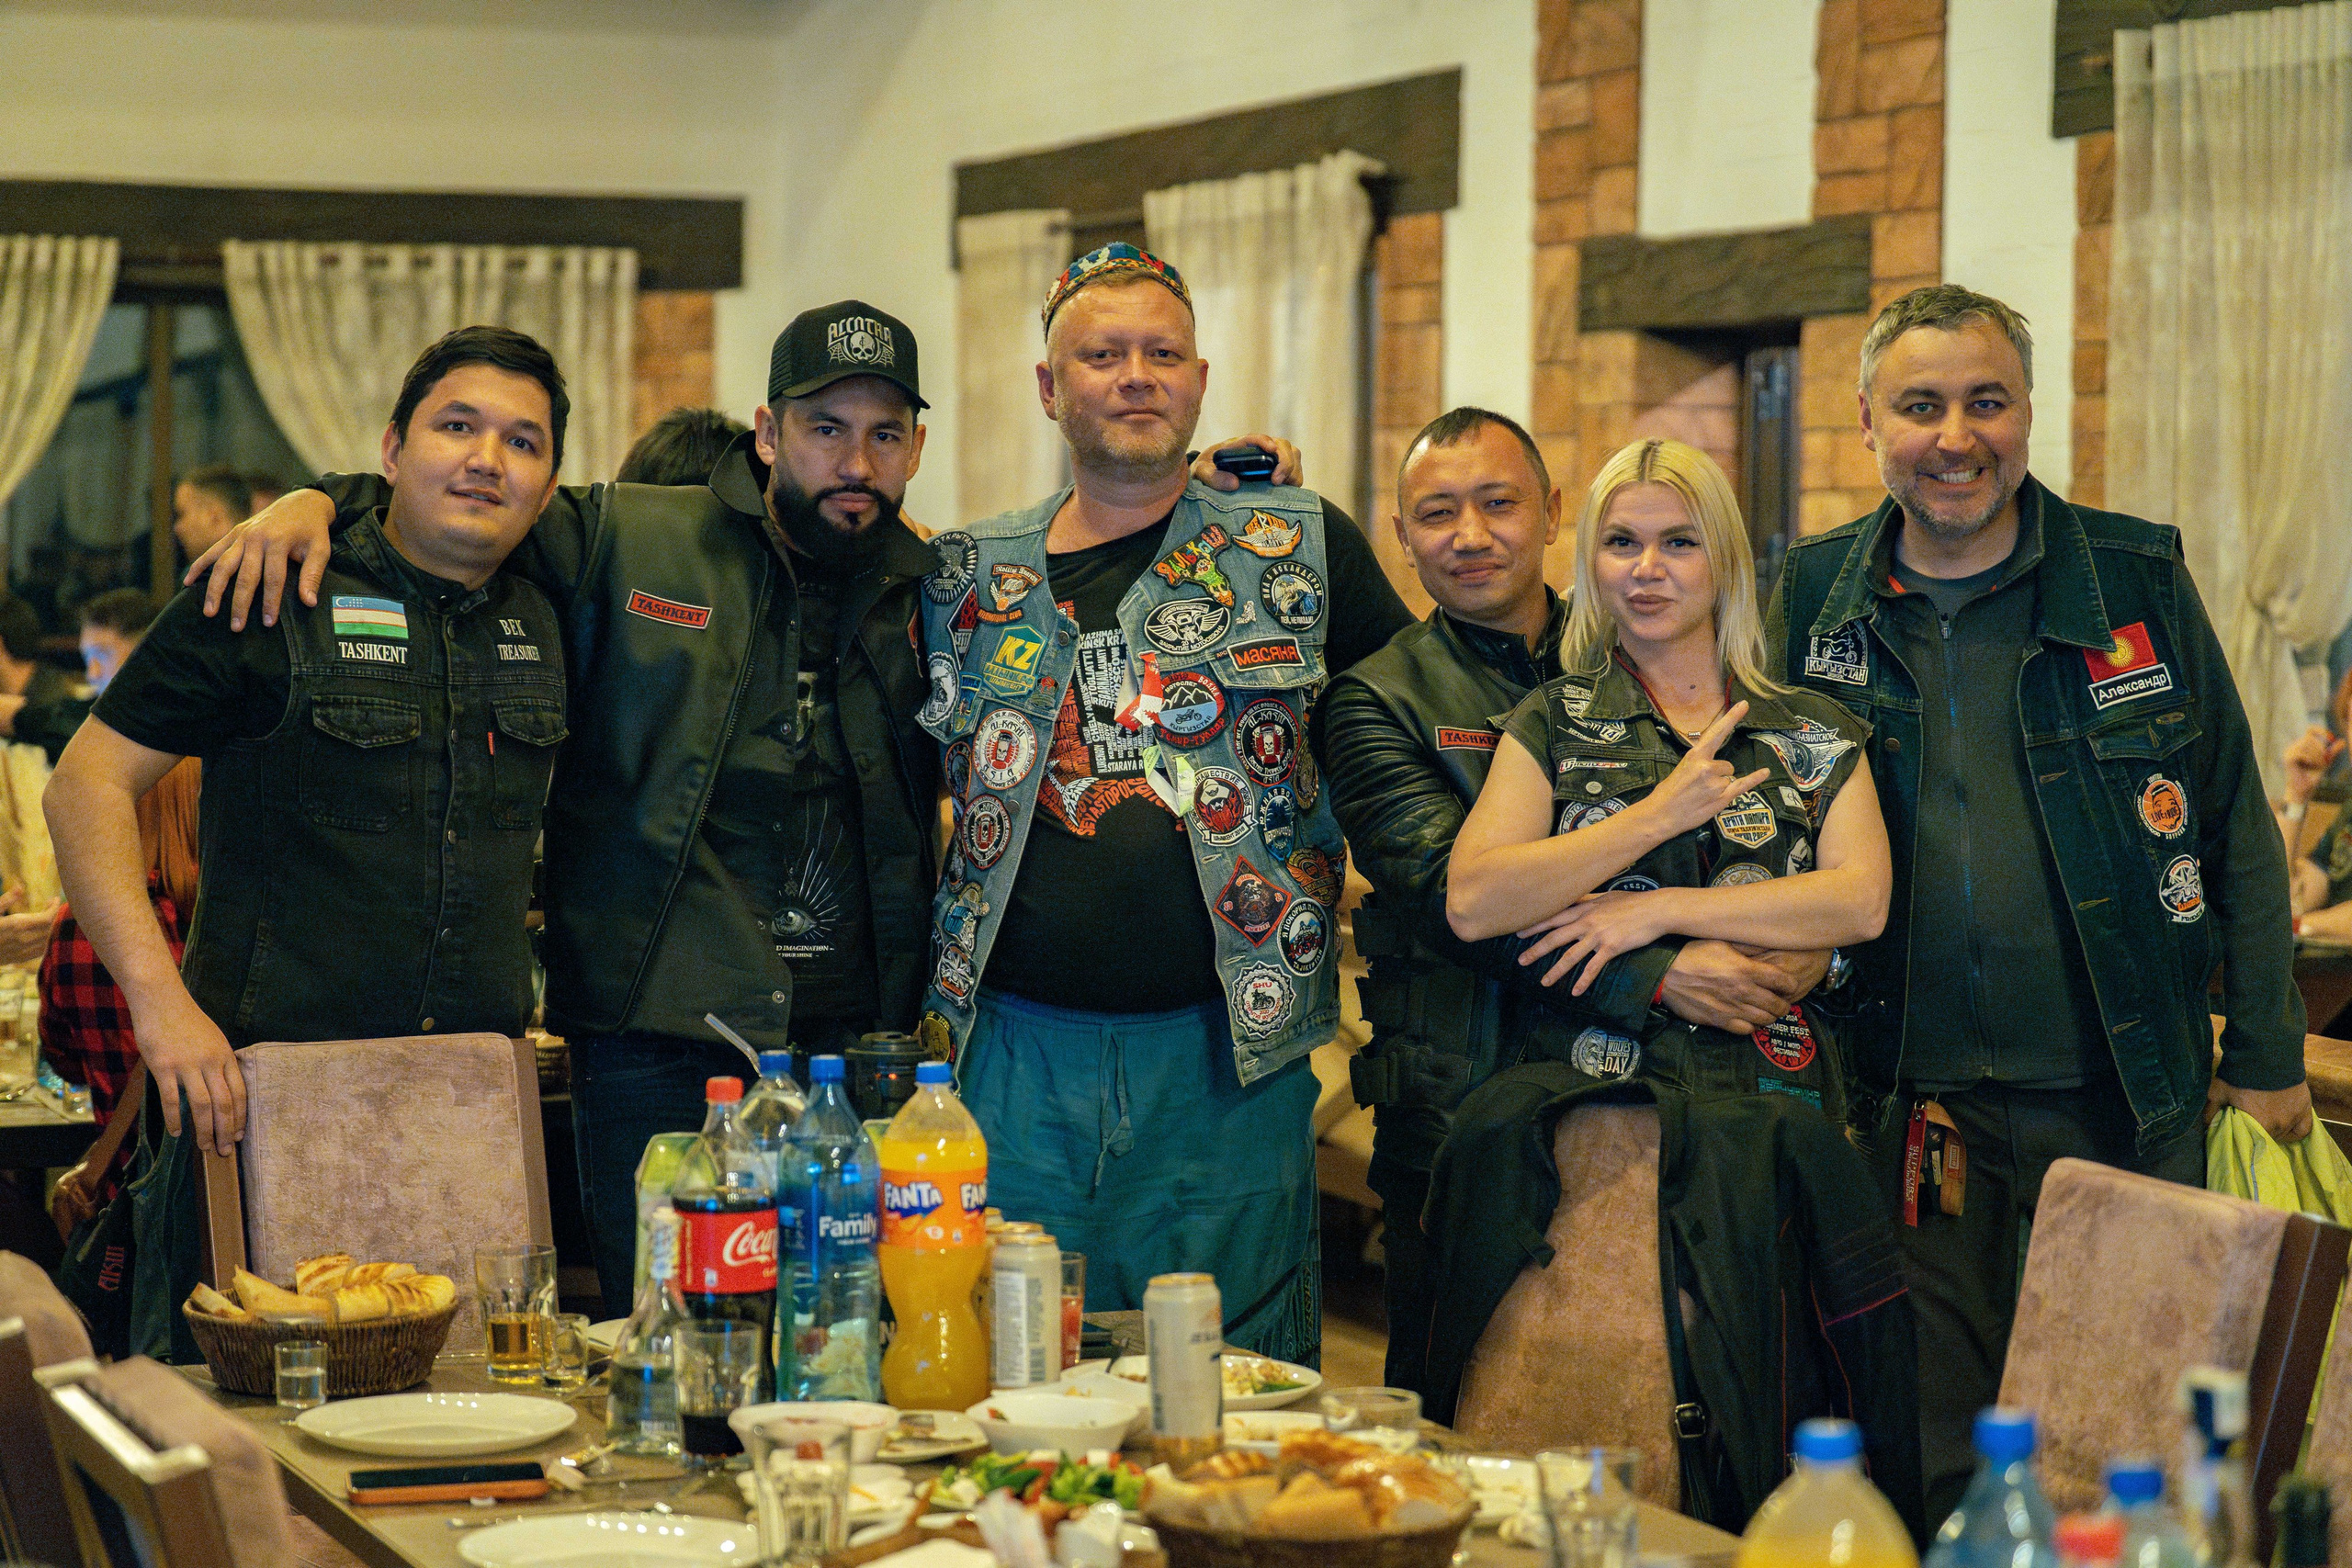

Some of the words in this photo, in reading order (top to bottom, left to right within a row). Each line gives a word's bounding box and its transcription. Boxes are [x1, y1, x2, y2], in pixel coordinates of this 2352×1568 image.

[934, 533, 974, 547] ОТКРЫТИЕ
[637, 598, 705, 624] TASHKENT
[499, 619, 526, 637] BEK
[1159, 640, 1190, 651] ЗАКРЫТИЕ
[1191, 626, 1225, 650] МОТОСЕЗОНА
[338, 641, 408, 664] TASHKENT
[497, 644, 541, 661] TREASURER
[995, 635, 1042, 671] KZ
[1082, 649, 1098, 695] TOGLIATTI
[1165, 681, 1198, 694] МОТОСЛЕТ
[2098, 673, 2167, 702] Александр
[1169, 716, 1213, 732] КЫРГЫЗСТАН
[1248, 710, 1286, 728] AL-KASHI
[990, 719, 1025, 738] AL-KASHI
[1445, 731, 1500, 746] TASHKE
[1108, 760, 1138, 773] STARAYA
[1077, 779, 1136, 837] SEVASTOPOL
[1623, 883, 1646, 891] FEST
[1252, 981, 1272, 989] SHU
[1790, 1025, 1810, 1036] FEST
[1607, 1041, 1632, 1053] WOLVES
[1604, 1056, 1629, 1074] DAY
[961, 1179, 987, 1210] FAN
[819, 1213, 876, 1237] Family
